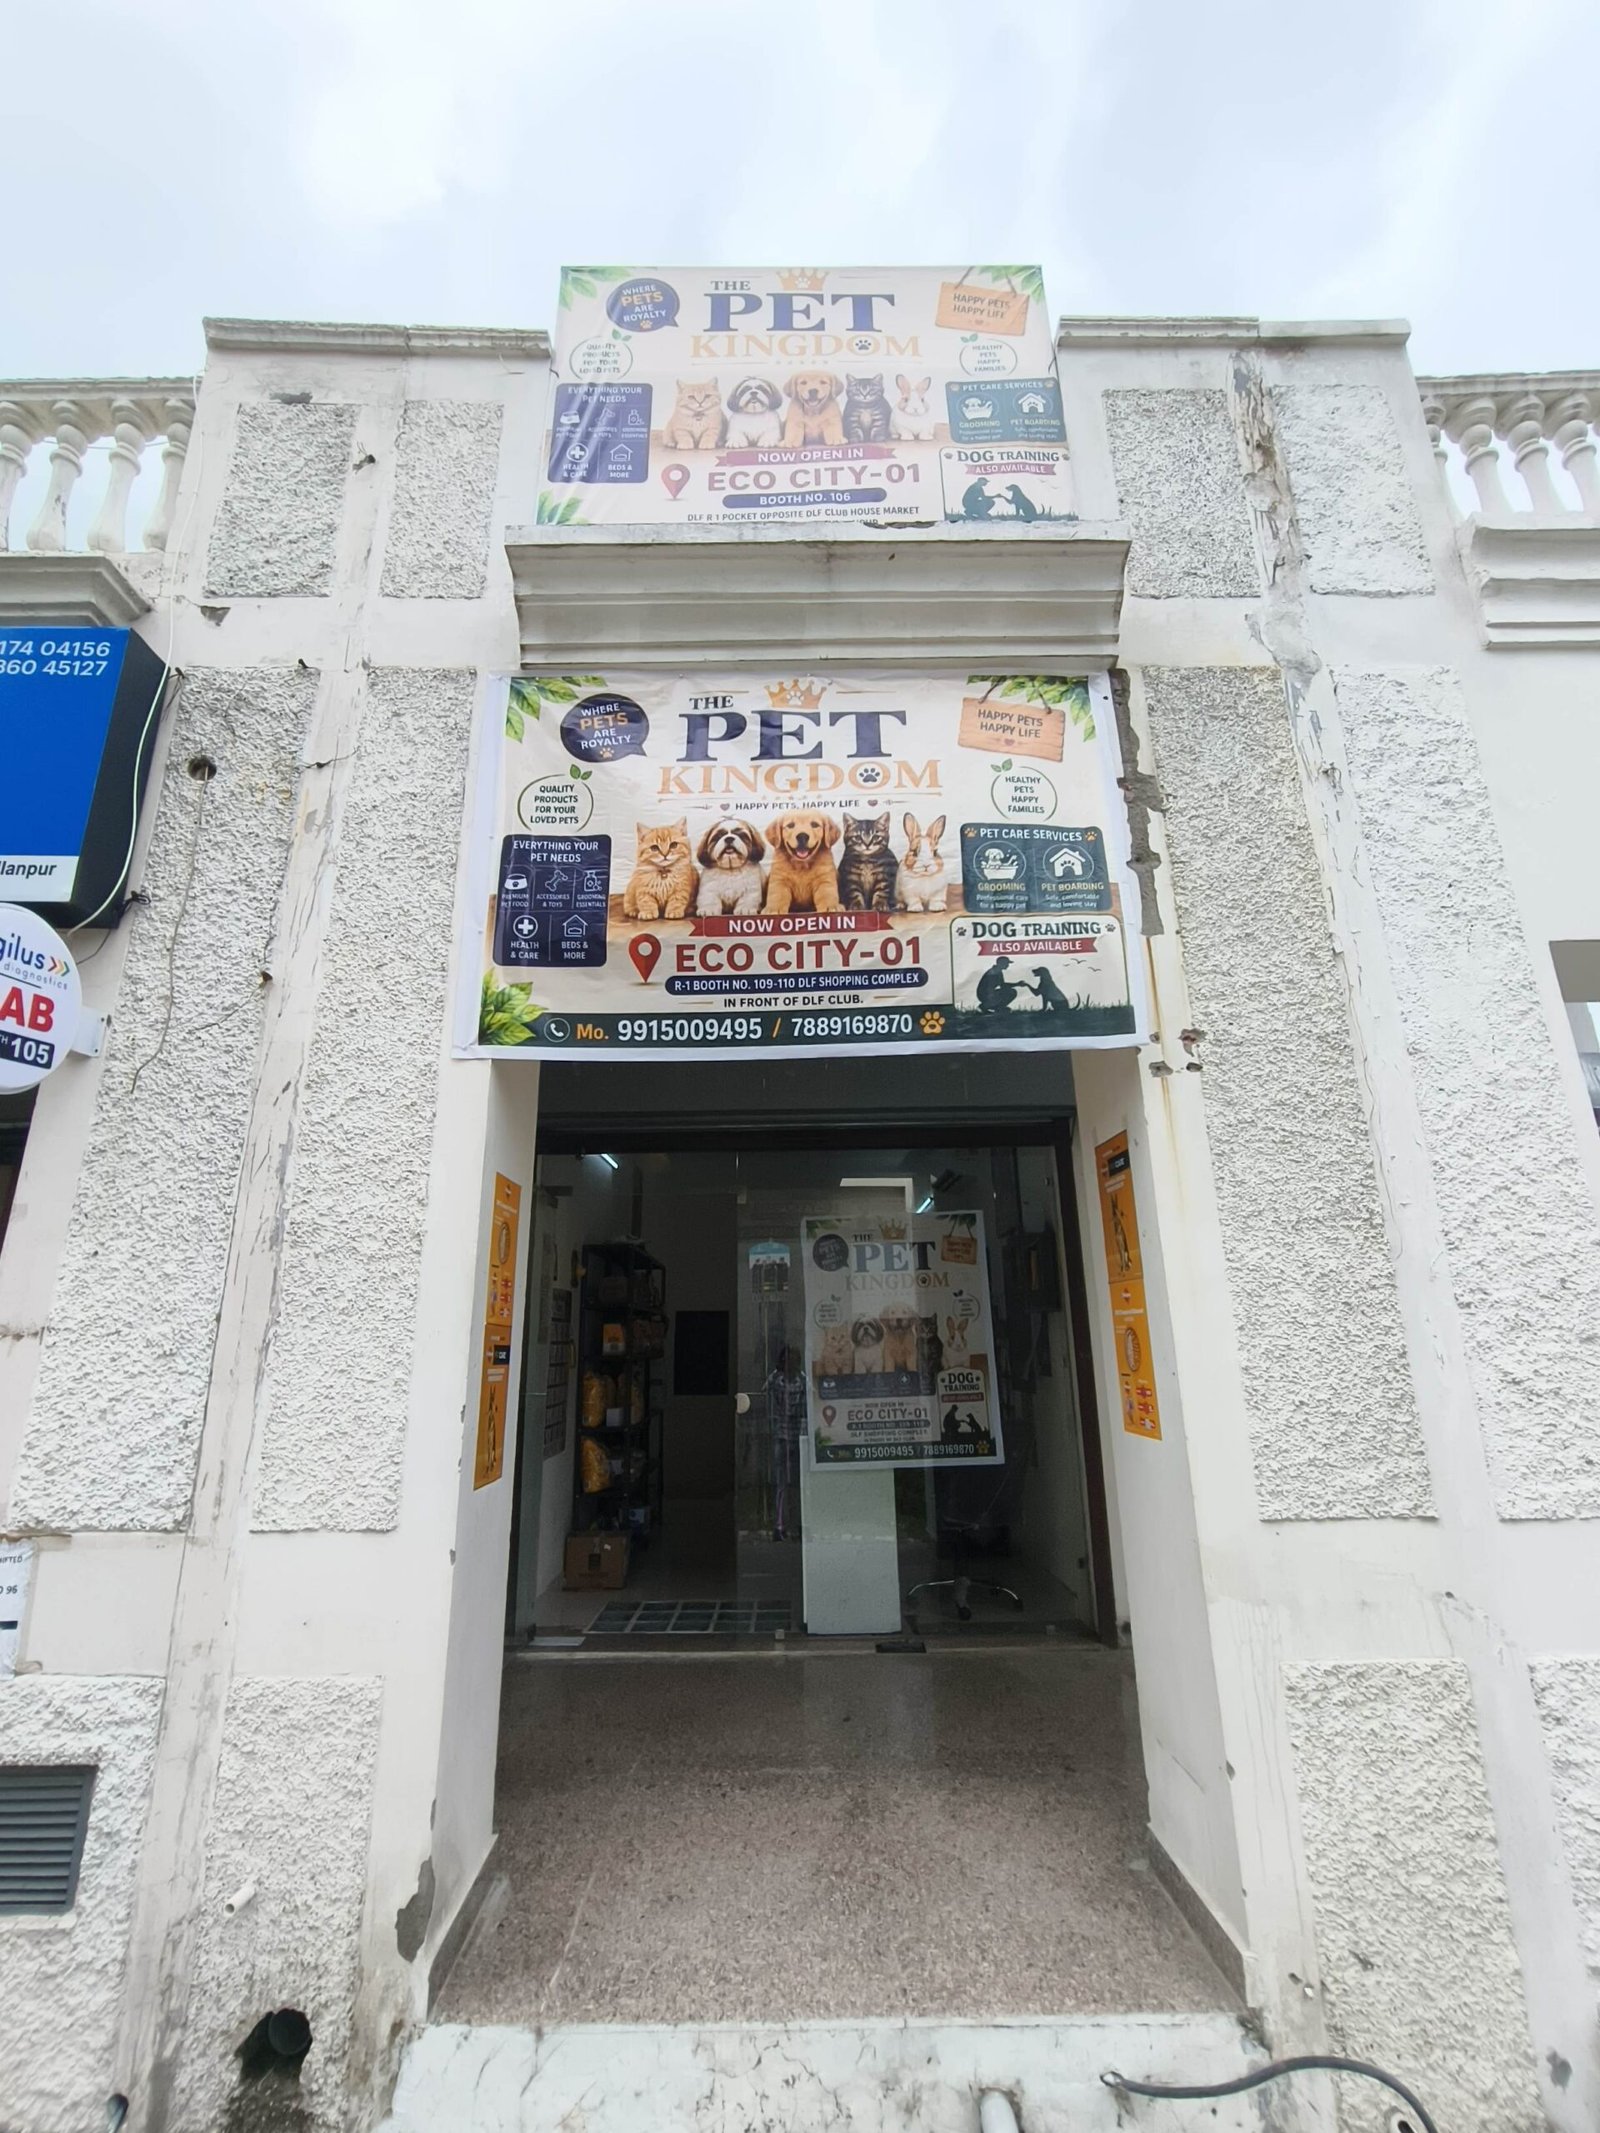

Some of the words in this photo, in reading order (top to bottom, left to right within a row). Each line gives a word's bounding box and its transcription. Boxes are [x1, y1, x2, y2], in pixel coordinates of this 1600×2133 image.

[622, 284, 656, 296] WHERE
[710, 280, 750, 291] THE
[620, 291, 664, 307] PETS
[953, 293, 986, 306] HAPPY
[988, 296, 1011, 309] PETS
[634, 304, 654, 314] ARE
[703, 293, 895, 332] PET
[953, 304, 985, 316] HAPPY
[986, 309, 1006, 320] LIFE
[623, 310, 666, 322] ROYALTY
[690, 334, 924, 358] KINGDOM
[620, 386, 642, 394] YOUR
[962, 383, 978, 392] PET
[980, 382, 1002, 391] CARE
[1004, 382, 1044, 390] SERVICES
[959, 420, 1000, 428] GROOMING
[1026, 418, 1060, 426] BOARDING
[758, 452, 794, 462] NOW
[800, 450, 846, 461] OPEN
[848, 448, 863, 458] IN
[958, 450, 994, 462] DOG
[998, 450, 1060, 462] TRAINING
[976, 464, 998, 474] ALSO
[1000, 464, 1046, 473] AVAILABLE
[708, 470, 776, 491] ECO
[790, 463, 920, 488] CITY-01
[760, 494, 800, 505] BOOTH
[805, 492, 826, 502] NO.
[830, 492, 850, 502] 106
[722, 512, 758, 521] POCKET
[760, 510, 804, 520] OPPOSITE
[806, 508, 822, 517] DLF
[824, 508, 848, 516] CLUB
[850, 506, 881, 516] HOUSE
[883, 506, 920, 515] MARKET
[40, 640, 110, 656] 04156
[42, 660, 108, 676] 45127
[580, 702, 620, 717] WHERE
[689, 696, 734, 710] THE
[580, 712, 628, 730] PETS
[978, 709, 1014, 722] HAPPY
[1016, 714, 1044, 726] PETS
[593, 728, 616, 738] ARE
[676, 710, 906, 762] PET
[980, 722, 1016, 735] HAPPY
[1018, 728, 1041, 738] LIFE
[580, 734, 632, 750] ROYALTY
[656, 760, 944, 794] KINGDOM
[1005, 776, 1042, 784] HEALTHY
[539, 784, 575, 793] QUALITY
[1014, 786, 1034, 794] PETS
[534, 794, 578, 804] PRODUCTS
[736, 802, 769, 811] HAPPY
[802, 800, 836, 809] HAPPY
[838, 799, 860, 808] LIFE
[1011, 795, 1039, 804] HAPPY
[535, 806, 550, 814] FOR
[553, 805, 576, 814] YOUR
[1008, 804, 1045, 814] FAMILIES
[530, 816, 556, 824] LOVED
[558, 816, 578, 824] PETS
[980, 828, 1000, 839] PET
[1002, 828, 1030, 839] CARE
[1033, 830, 1082, 841] SERVICES
[512, 840, 572, 851] EVERYTHING
[574, 842, 598, 850] YOUR
[530, 853, 548, 862] PET
[550, 854, 582, 862] NEEDS
[978, 882, 1026, 892] GROOMING
[1041, 882, 1057, 891] PET
[1058, 882, 1104, 892] BOARDING
[728, 920, 774, 933] NOW
[780, 918, 830, 932] OPEN
[837, 916, 856, 929] IN
[972, 922, 1017, 938] DOG
[1021, 922, 1102, 936] TRAINING
[992, 942, 1021, 952] ALSO
[1024, 940, 1082, 952] AVAILABLE
[518, 952, 539, 960] CARE
[564, 952, 586, 960] MORE
[676, 943, 754, 973] ECO
[767, 936, 920, 970] CITY-01
[4, 961, 68, 990] diagnostics
[674, 981, 690, 992] R-1
[692, 980, 730, 992] BOOTH
[732, 978, 751, 990] NO.
[754, 976, 796, 990] 109-110
[798, 976, 818, 988] DLF
[819, 974, 869, 988] SHOPPING
[871, 972, 920, 986] COMPLEX
[724, 998, 736, 1008] IN
[739, 996, 780, 1008] FRONT
[784, 996, 799, 1006] OF
[802, 995, 824, 1006] DLF
[828, 994, 864, 1005] CLUB.
[576, 1024, 609, 1040] Mo.
[618, 1018, 762, 1042] 9915009495
[772, 1016, 782, 1038] /
[792, 1013, 914, 1038] 7889169870
[12, 1037, 50, 1064] 105
[855, 1242, 936, 1272] PET
[846, 1272, 950, 1292] KINGDOM
[948, 1372, 974, 1384] DOG
[944, 1384, 980, 1392] TRAINING
[848, 1409, 874, 1421] ECO
[880, 1408, 928, 1420] CITY-01
[854, 1444, 914, 1458] 9915009495
[924, 1444, 974, 1456] 7889169870
